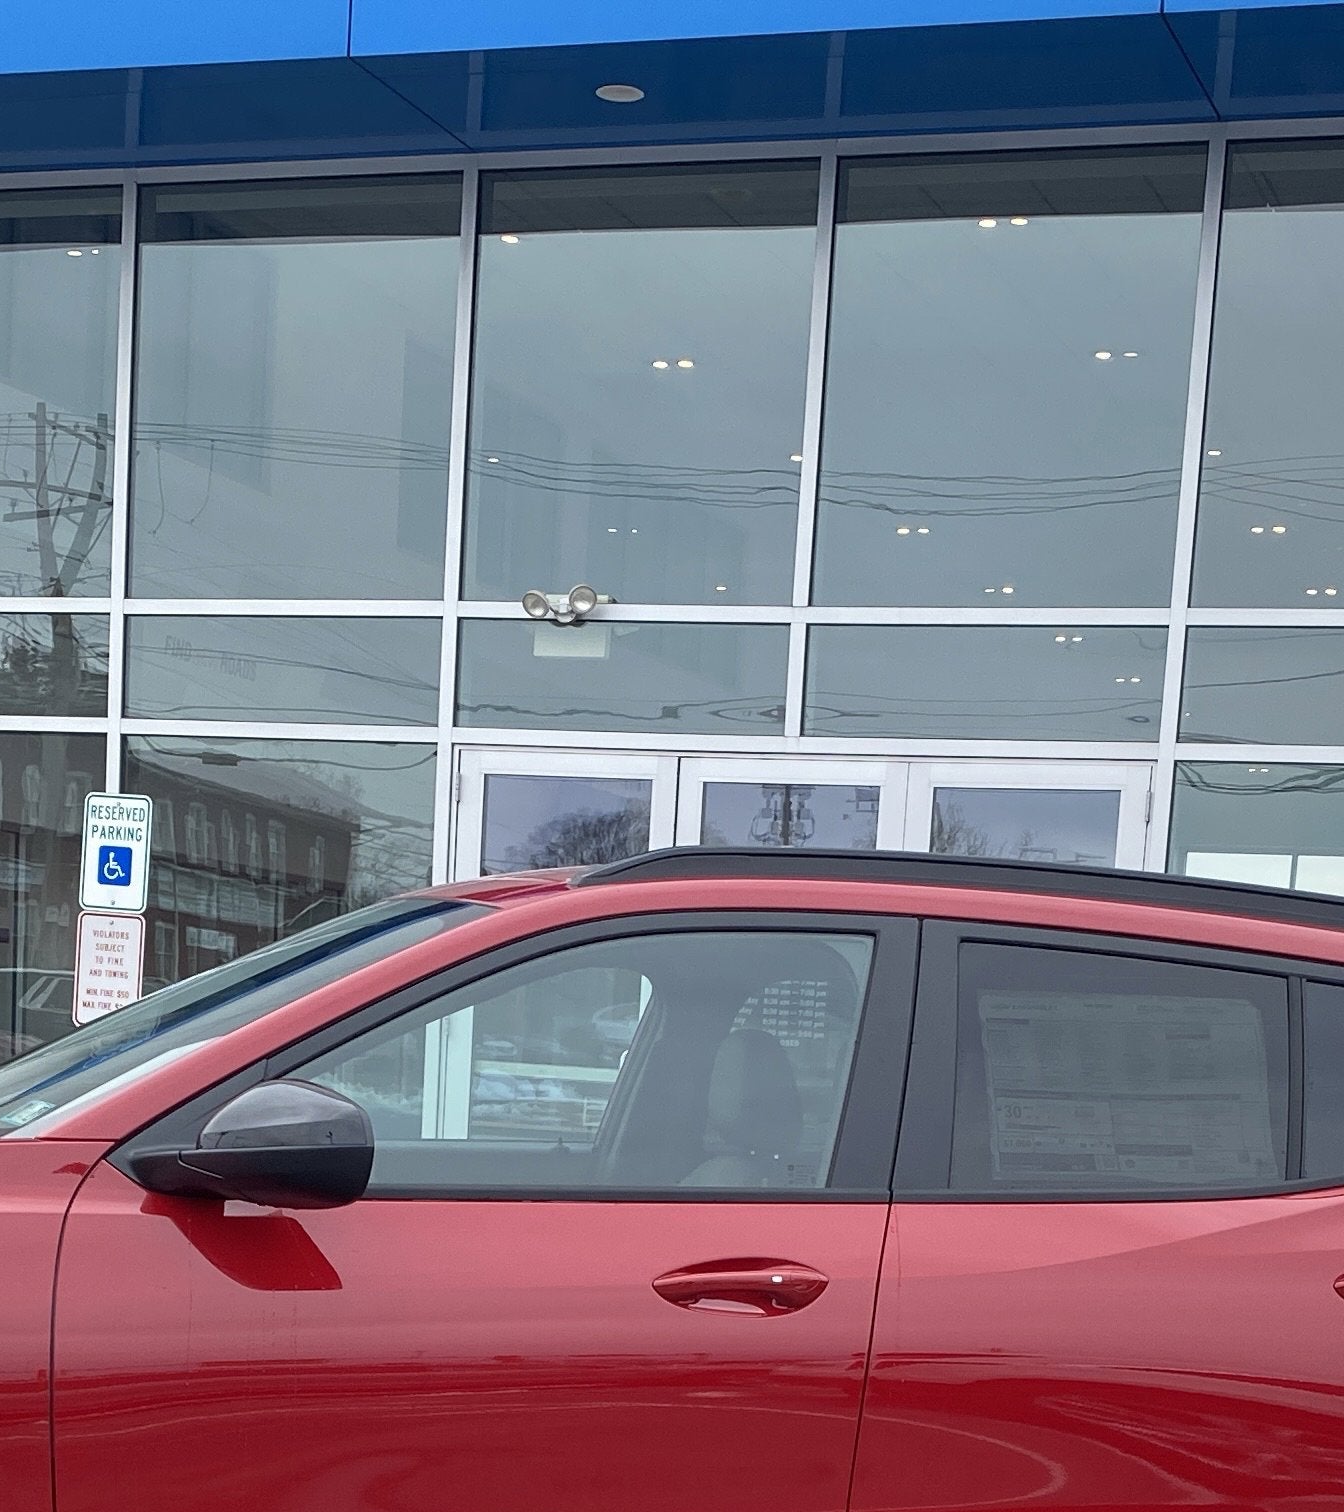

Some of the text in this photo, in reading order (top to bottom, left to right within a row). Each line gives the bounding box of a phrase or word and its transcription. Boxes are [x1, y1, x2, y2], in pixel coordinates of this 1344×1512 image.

[91, 805, 146, 822] RESERVED
[91, 825, 143, 842] PARKING
[92, 930, 129, 940] VIOLATORS
[95, 943, 125, 953] SUBJECT
[95, 956, 124, 966] TO FINE
[89, 969, 129, 979] AND TOWING
[100, 989, 114, 997] FINE
[117, 990, 130, 999] $50
[97, 1002, 111, 1010] FINE
